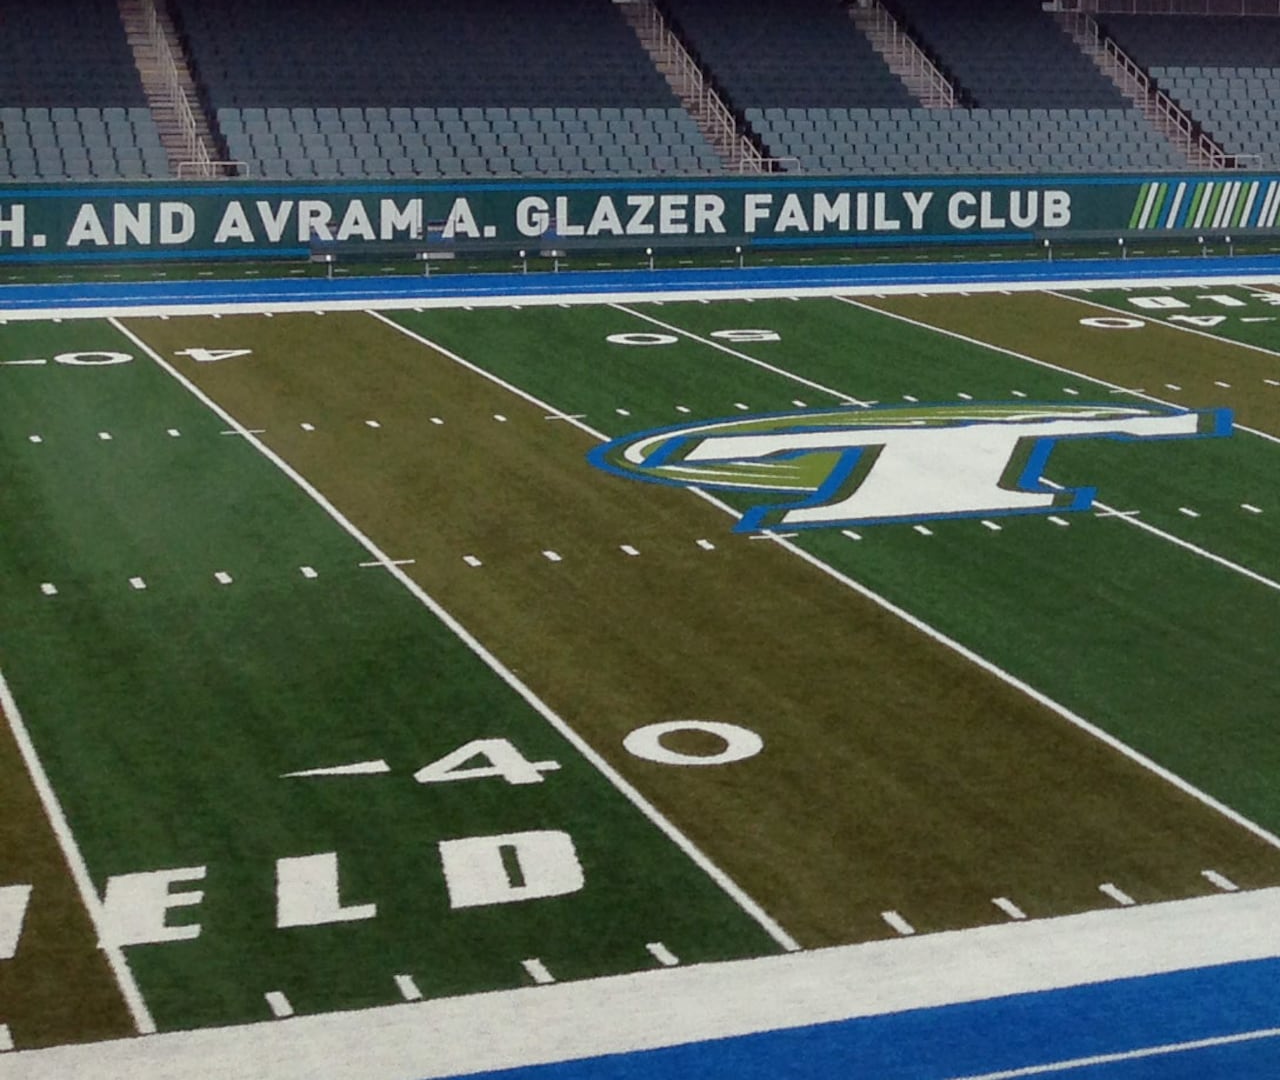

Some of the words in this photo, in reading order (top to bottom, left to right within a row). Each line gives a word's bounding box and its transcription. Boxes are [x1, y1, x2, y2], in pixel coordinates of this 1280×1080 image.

[66, 201, 195, 247] AND
[214, 198, 423, 243] AVRAM
[442, 197, 497, 240] A.
[516, 193, 727, 237] GLAZER
[745, 191, 934, 233] FAMILY
[948, 190, 1072, 230] CLUB
